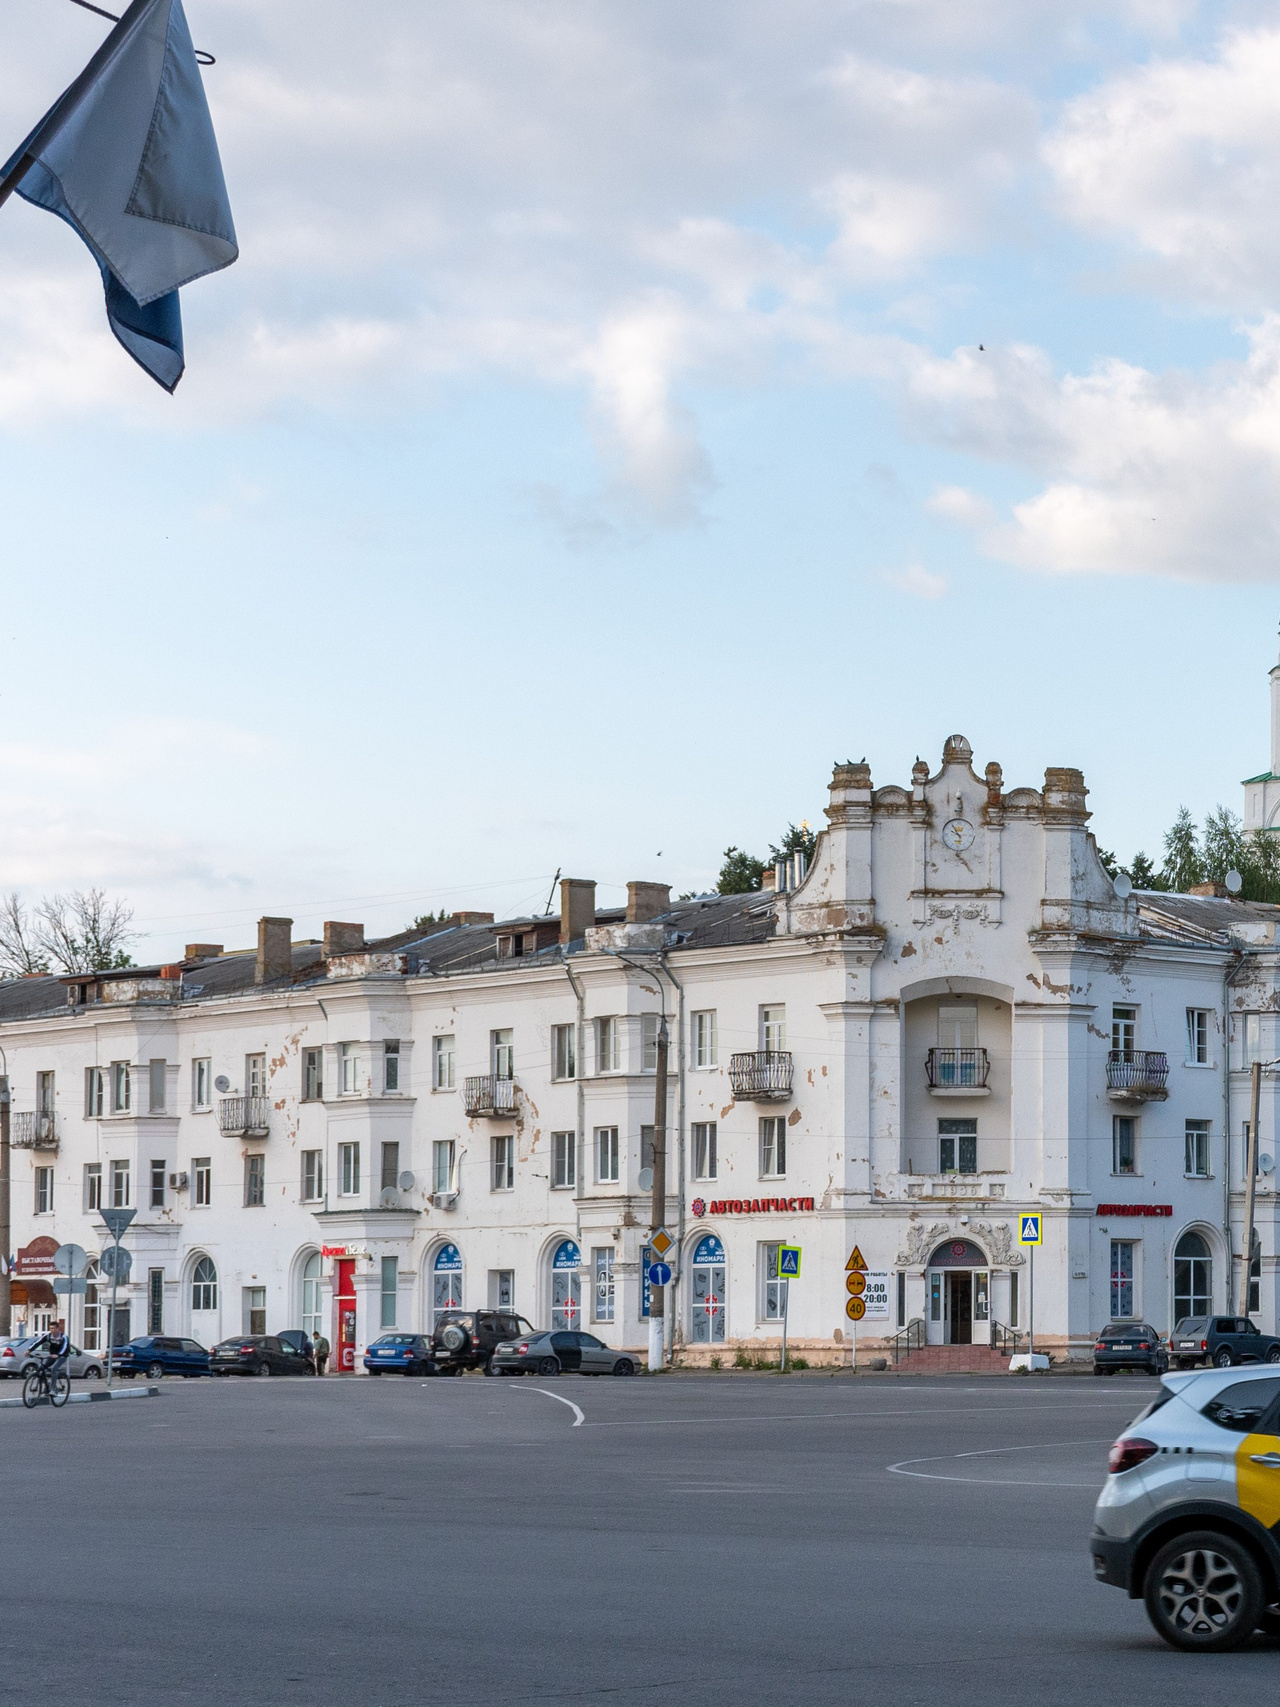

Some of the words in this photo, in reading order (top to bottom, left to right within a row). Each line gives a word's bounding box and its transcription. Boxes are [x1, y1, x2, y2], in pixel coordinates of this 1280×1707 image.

[709, 1197, 814, 1214] АВТОЗАПЧАСТИ
[1097, 1204, 1172, 1217] АВТОЗАПЧАСТИ
[22, 1256, 54, 1264] ВЫСТАВОЧНЫ
[866, 1284, 885, 1293] 8:00
[863, 1294, 888, 1303] 20:00
[849, 1303, 862, 1314] 40
